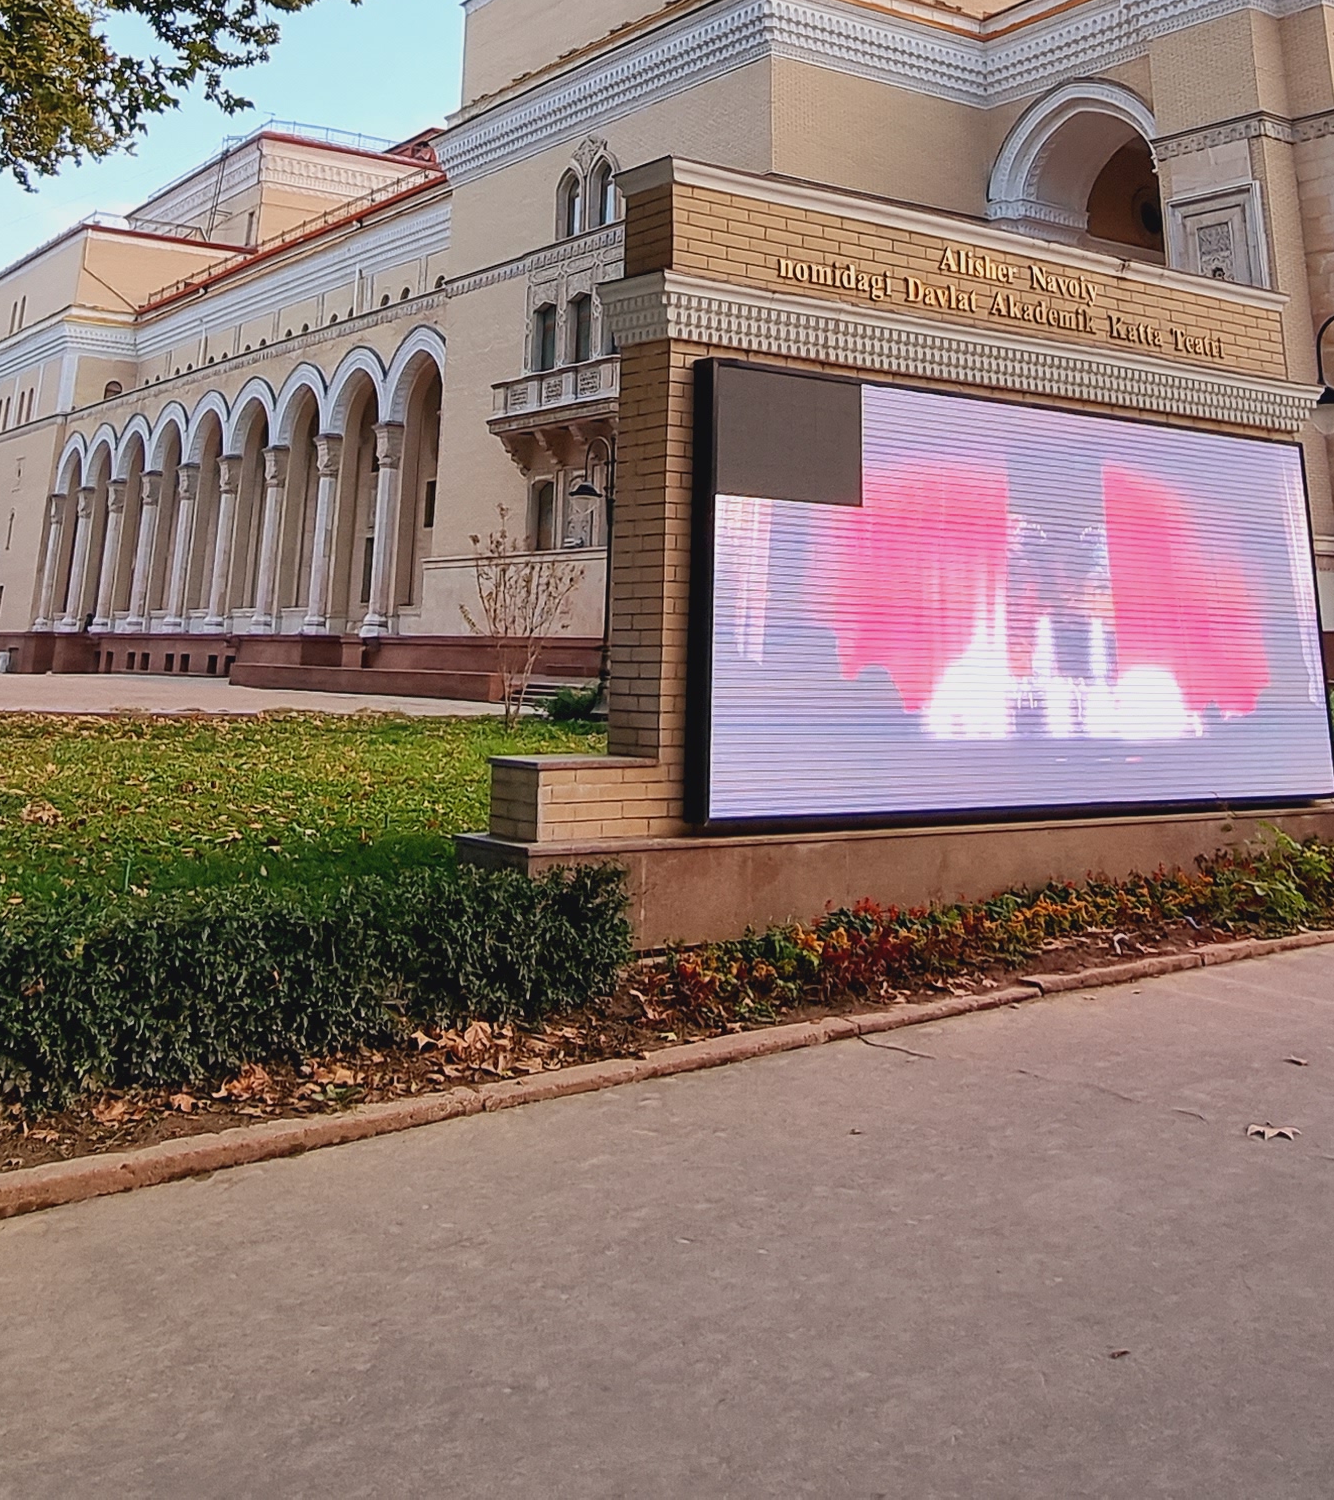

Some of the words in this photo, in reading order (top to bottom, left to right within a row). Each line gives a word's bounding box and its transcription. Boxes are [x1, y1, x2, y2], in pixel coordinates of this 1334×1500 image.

[777, 257, 892, 300] nomidagi
[905, 276, 978, 312] Davlat
[989, 291, 1096, 334] Akademik
[1107, 314, 1162, 347] Katta
[1170, 327, 1225, 359] Teatri
[939, 246, 1017, 284] Alisher
[1029, 265, 1098, 306] Navoiy
